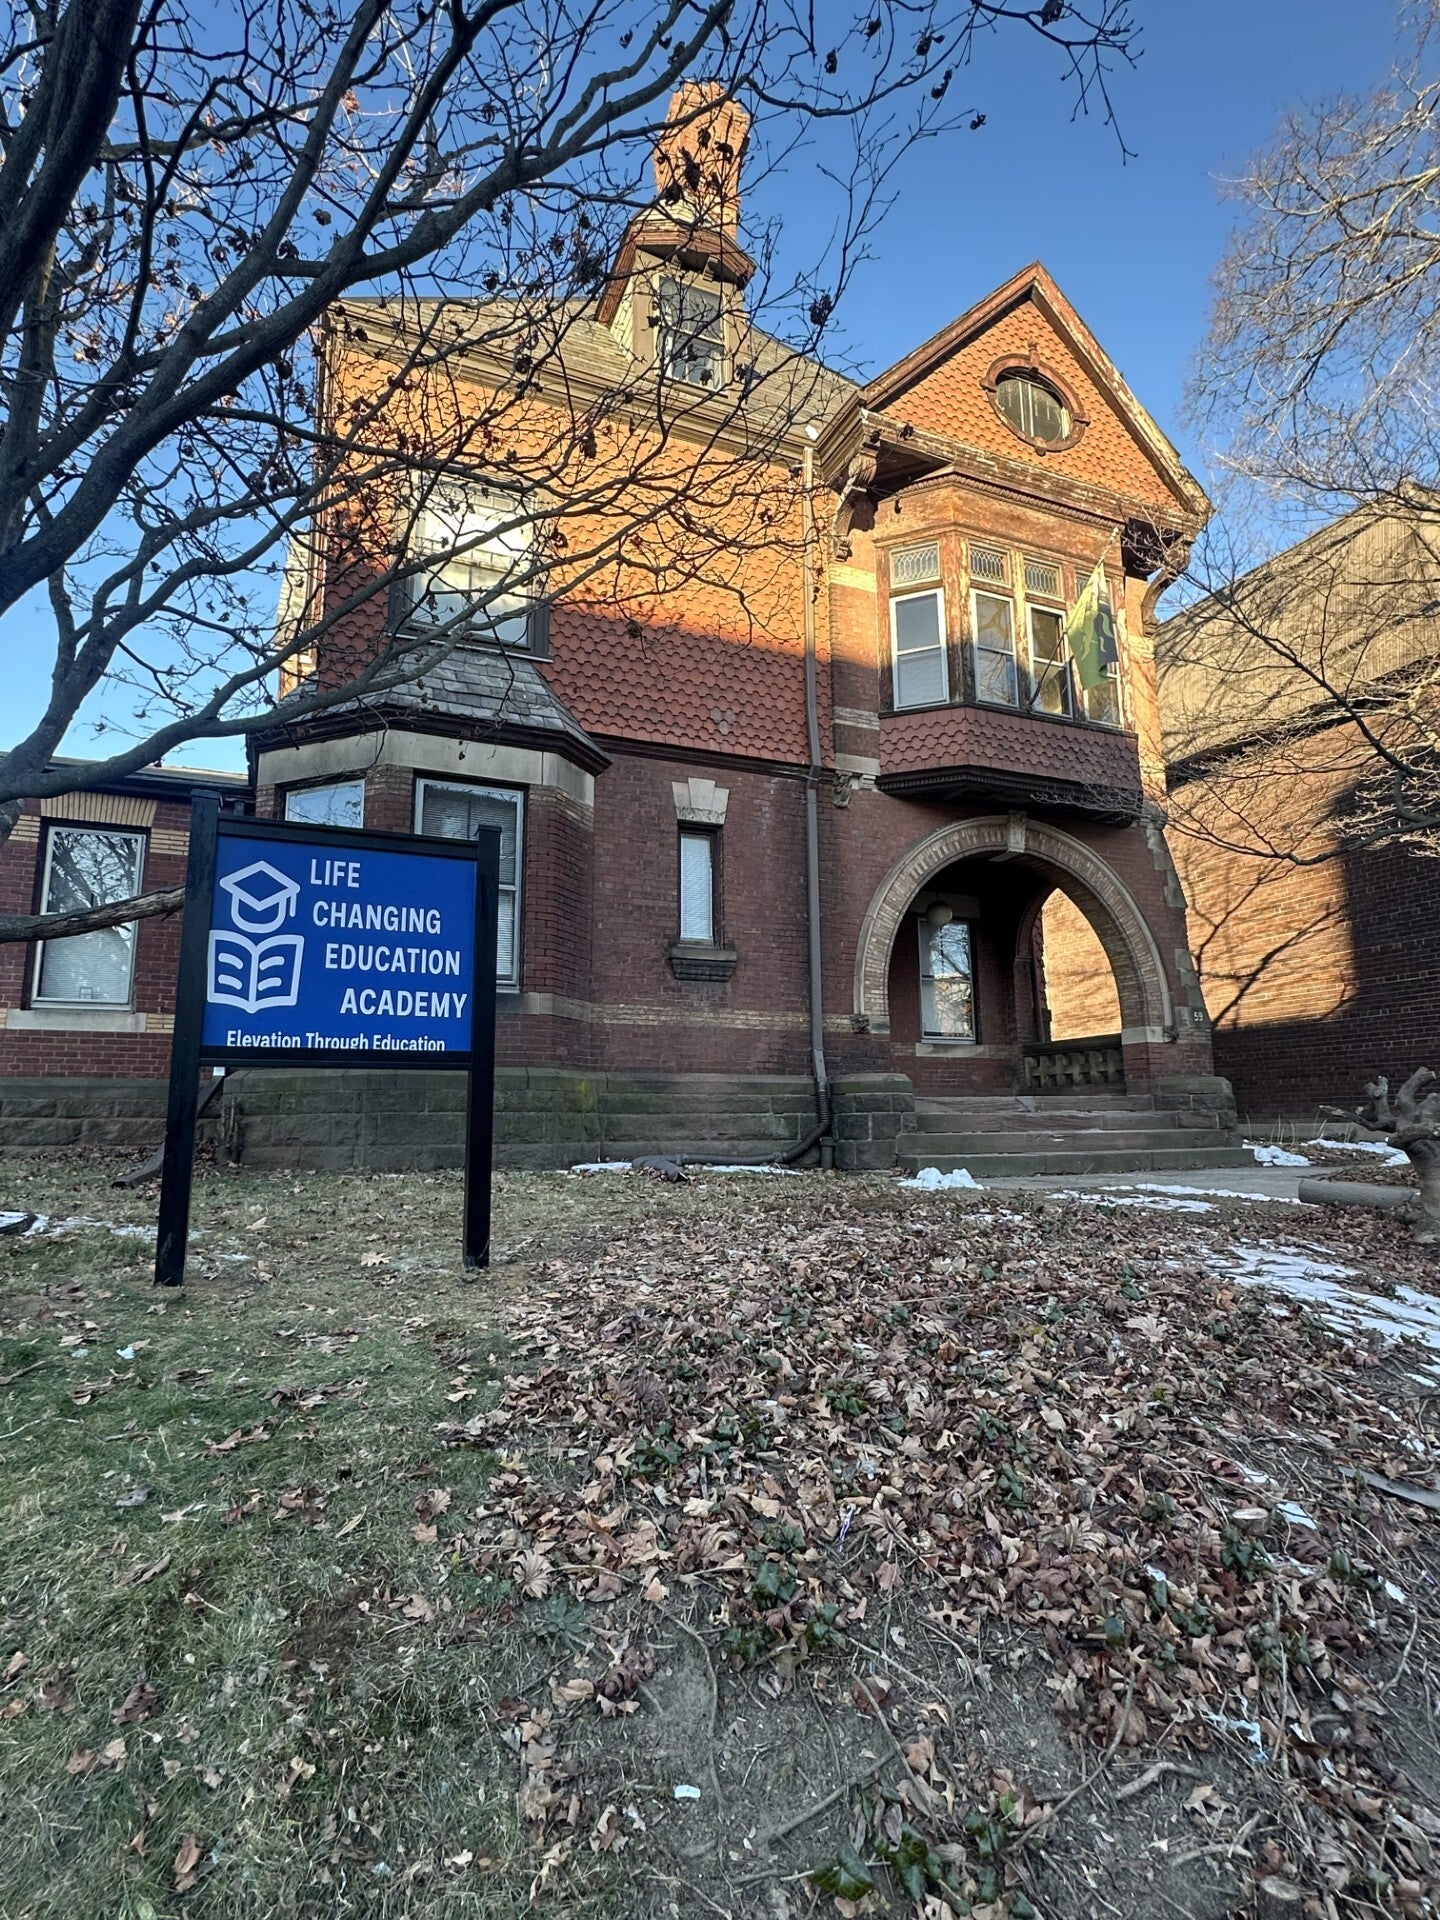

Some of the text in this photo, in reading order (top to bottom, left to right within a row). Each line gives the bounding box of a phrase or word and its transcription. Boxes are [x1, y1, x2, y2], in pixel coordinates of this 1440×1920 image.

[310, 858, 361, 888] LIFE
[312, 900, 441, 935] CHANGING
[325, 943, 461, 976] EDUCATION
[339, 988, 468, 1019] ACADEMY
[226, 1029, 446, 1052] Elevation Through Education
